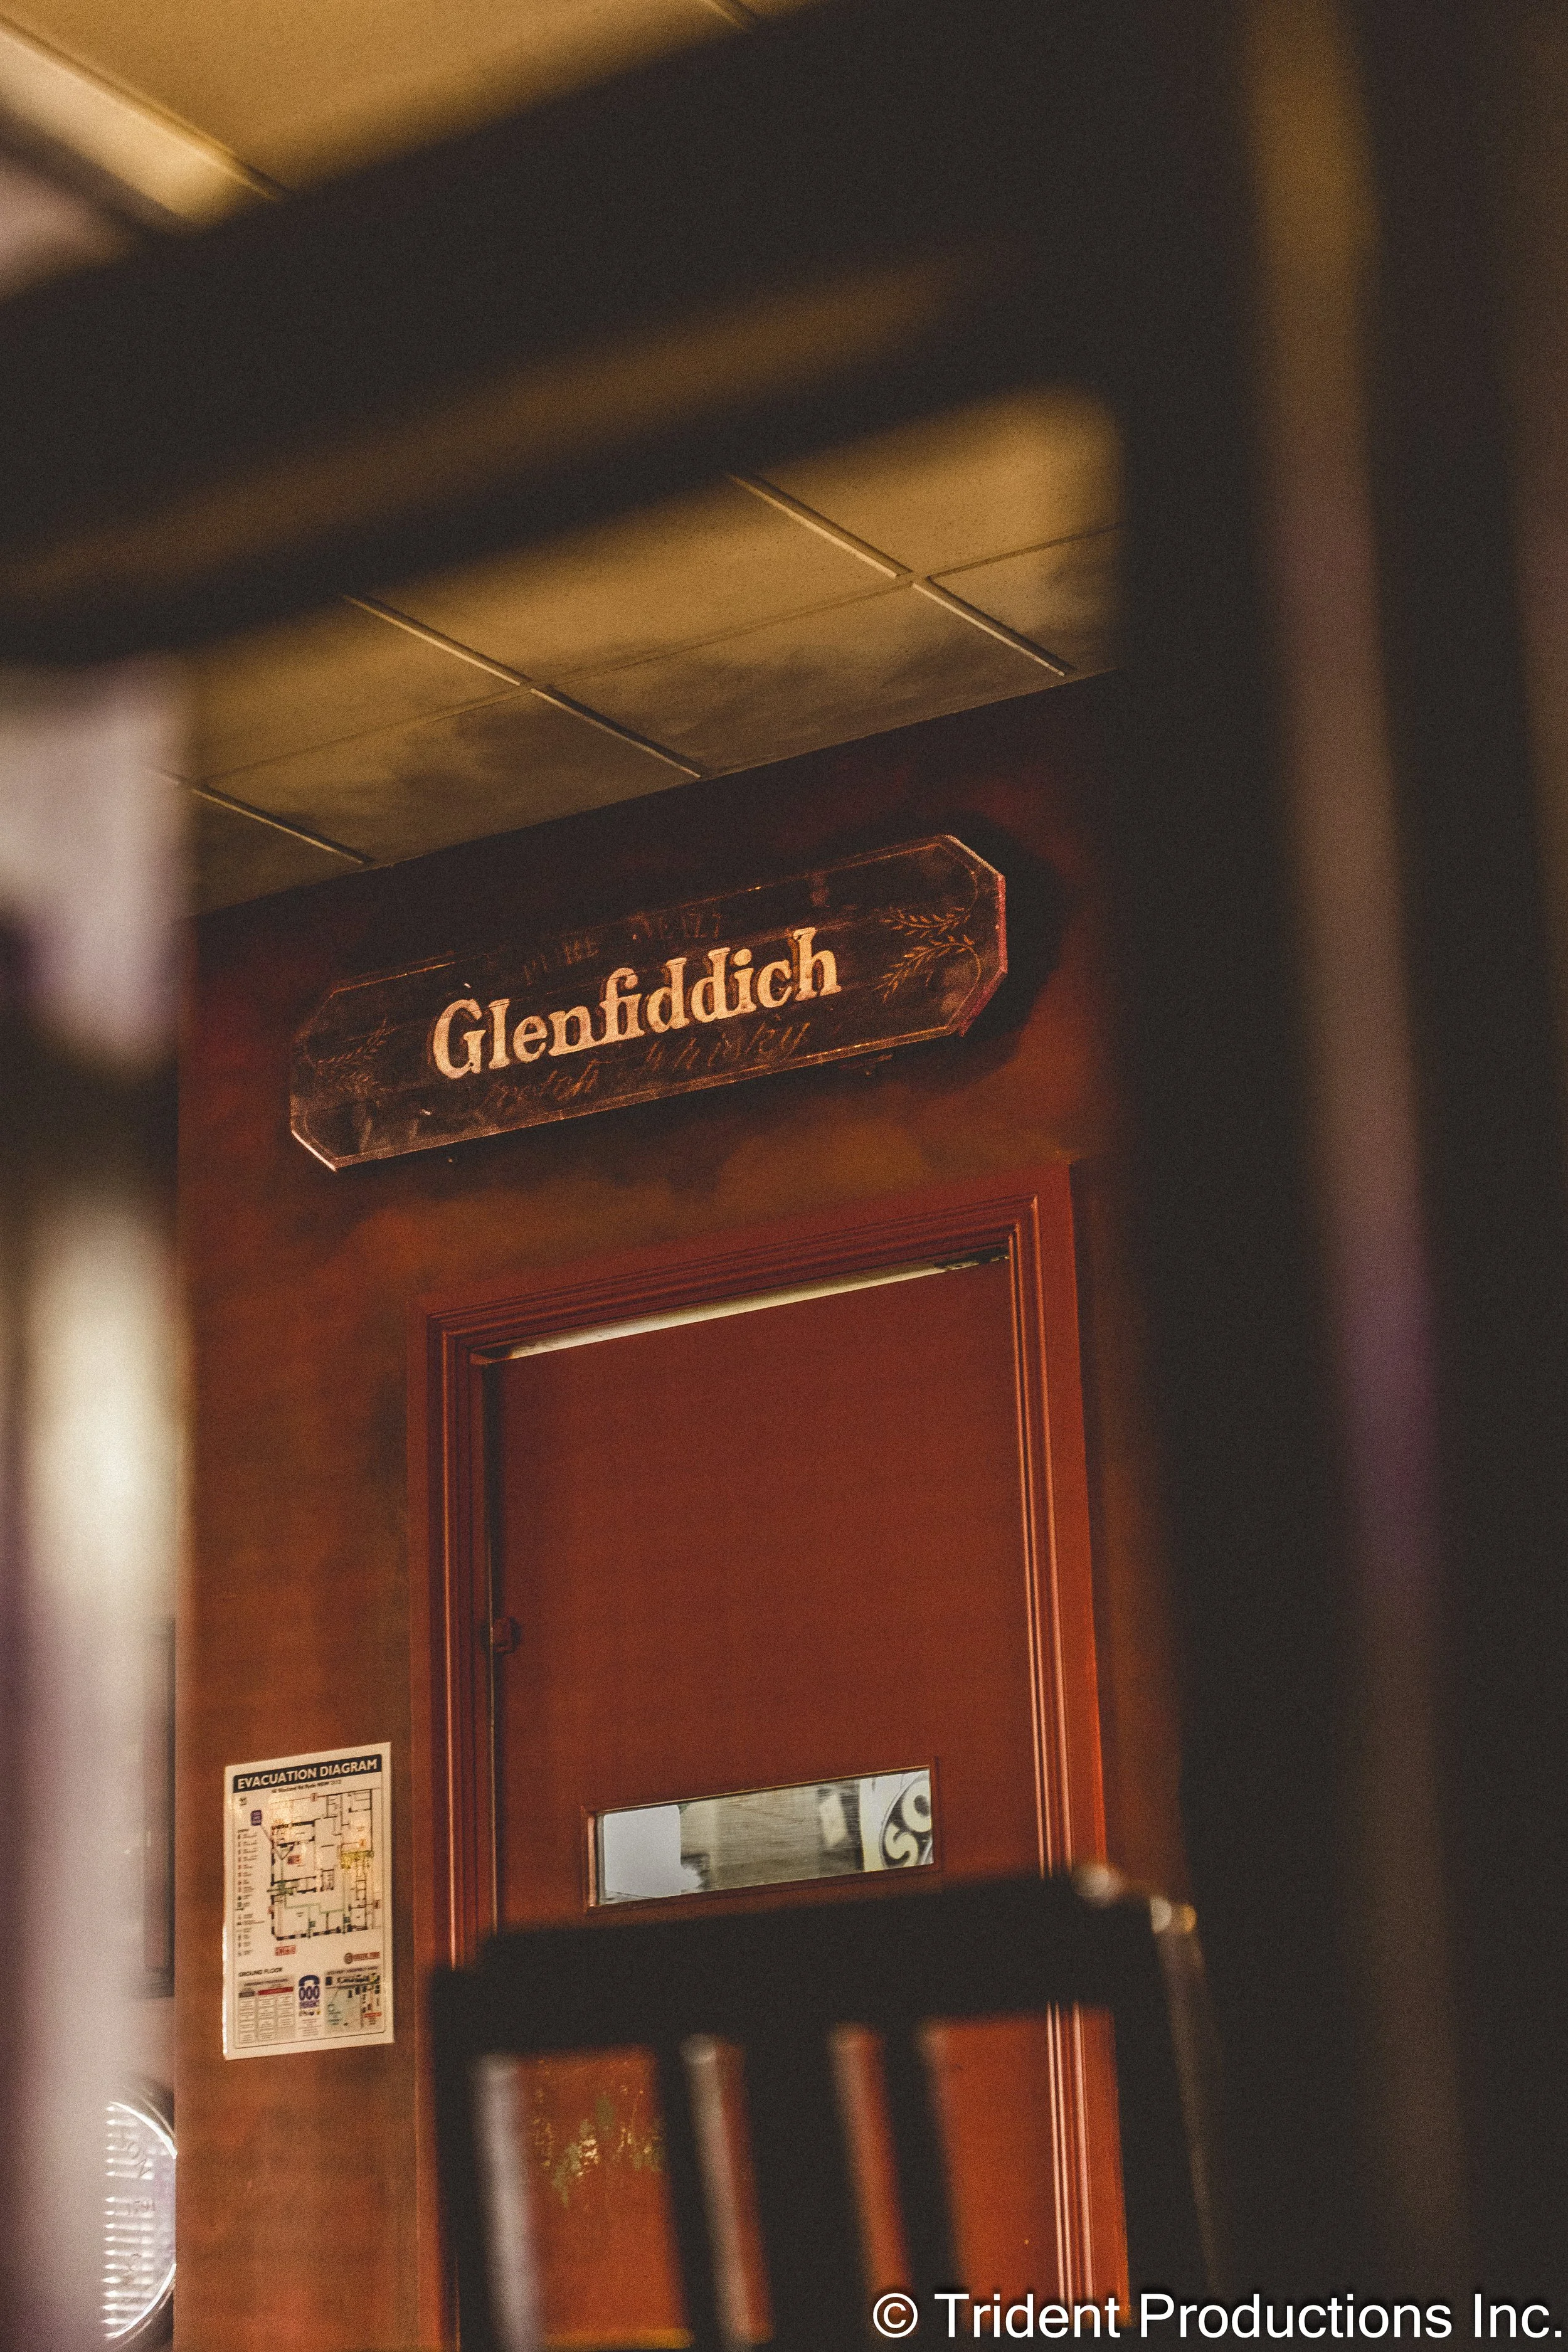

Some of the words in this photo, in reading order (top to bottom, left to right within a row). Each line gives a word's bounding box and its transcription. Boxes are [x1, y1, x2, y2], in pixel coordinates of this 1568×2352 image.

[431, 926, 842, 1079] Glenfiddich
[238, 1767, 317, 1789] EVACUATION
[319, 1759, 378, 1777] DIAGRAM
[299, 1985, 320, 2001] 000
